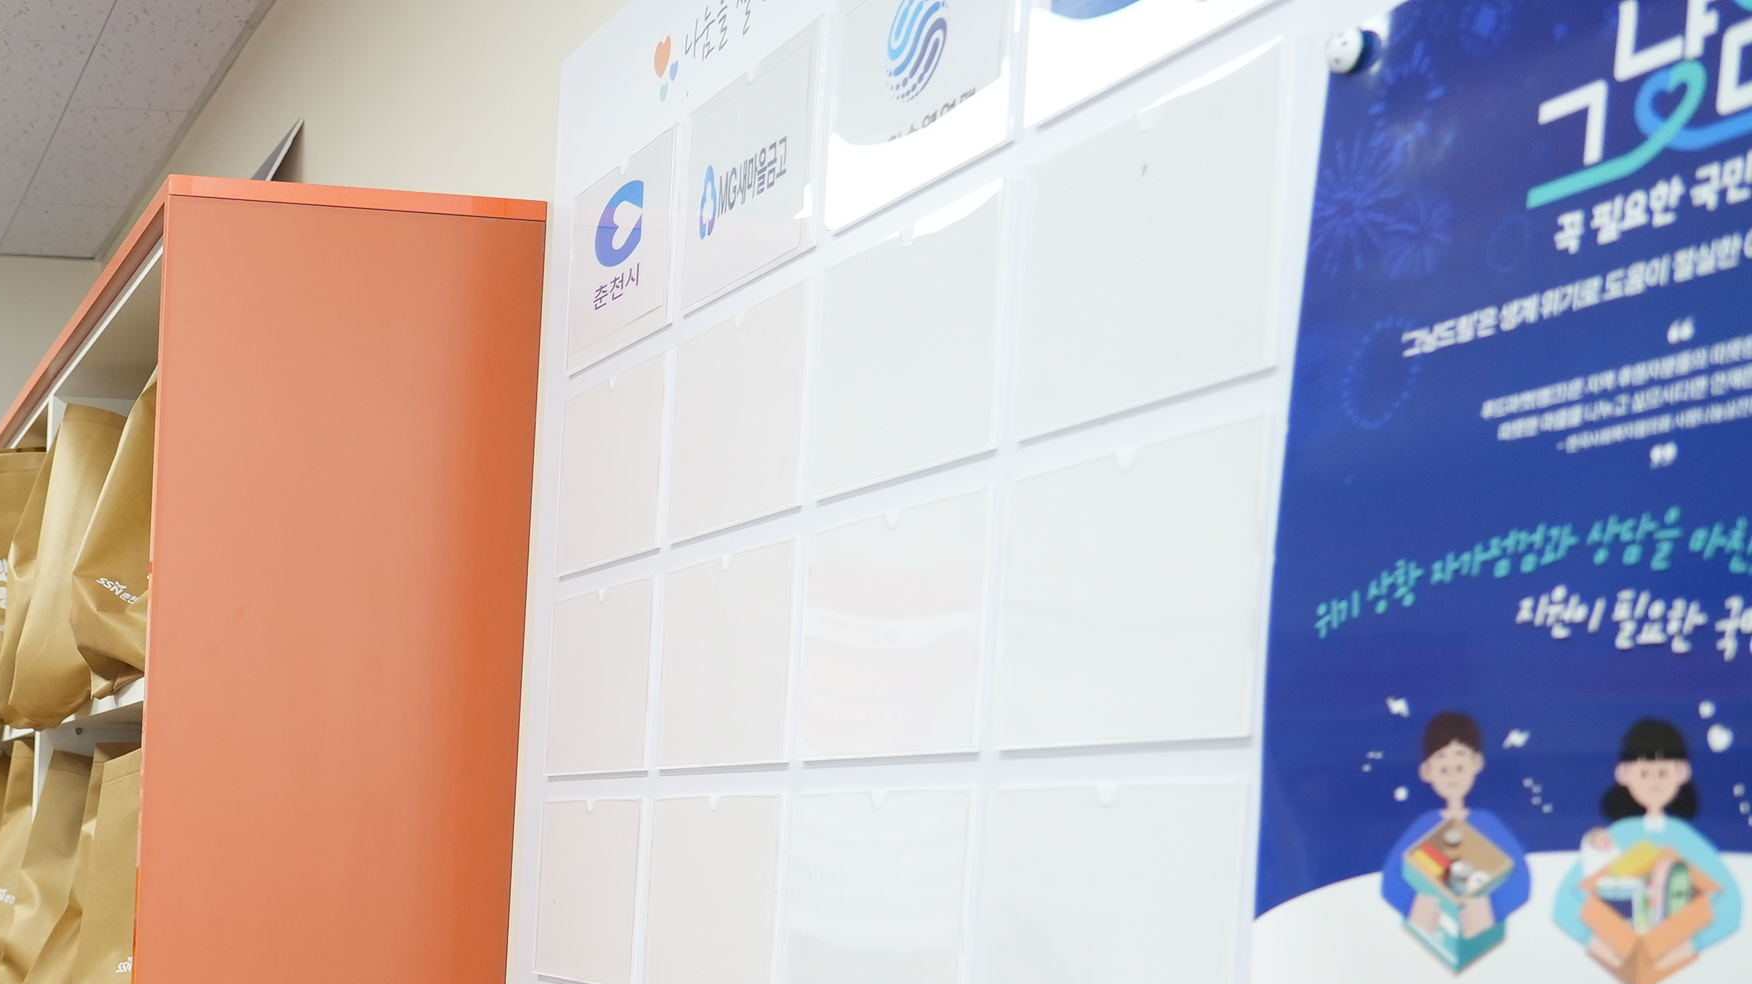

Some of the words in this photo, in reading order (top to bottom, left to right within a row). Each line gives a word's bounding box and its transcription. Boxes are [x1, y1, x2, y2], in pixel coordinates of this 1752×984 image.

[717, 136, 787, 217] MG새마을금고
[1590, 174, 1687, 245] 필요한
[593, 262, 640, 311] 춘천시
[1541, 275, 1603, 311] 위기로
[1603, 253, 1671, 301] 도움이
[1366, 557, 1424, 615] 상황
[1586, 504, 1684, 572] 상담을
[1515, 583, 1608, 639] 지원이
[1612, 588, 1709, 651] 필요한
